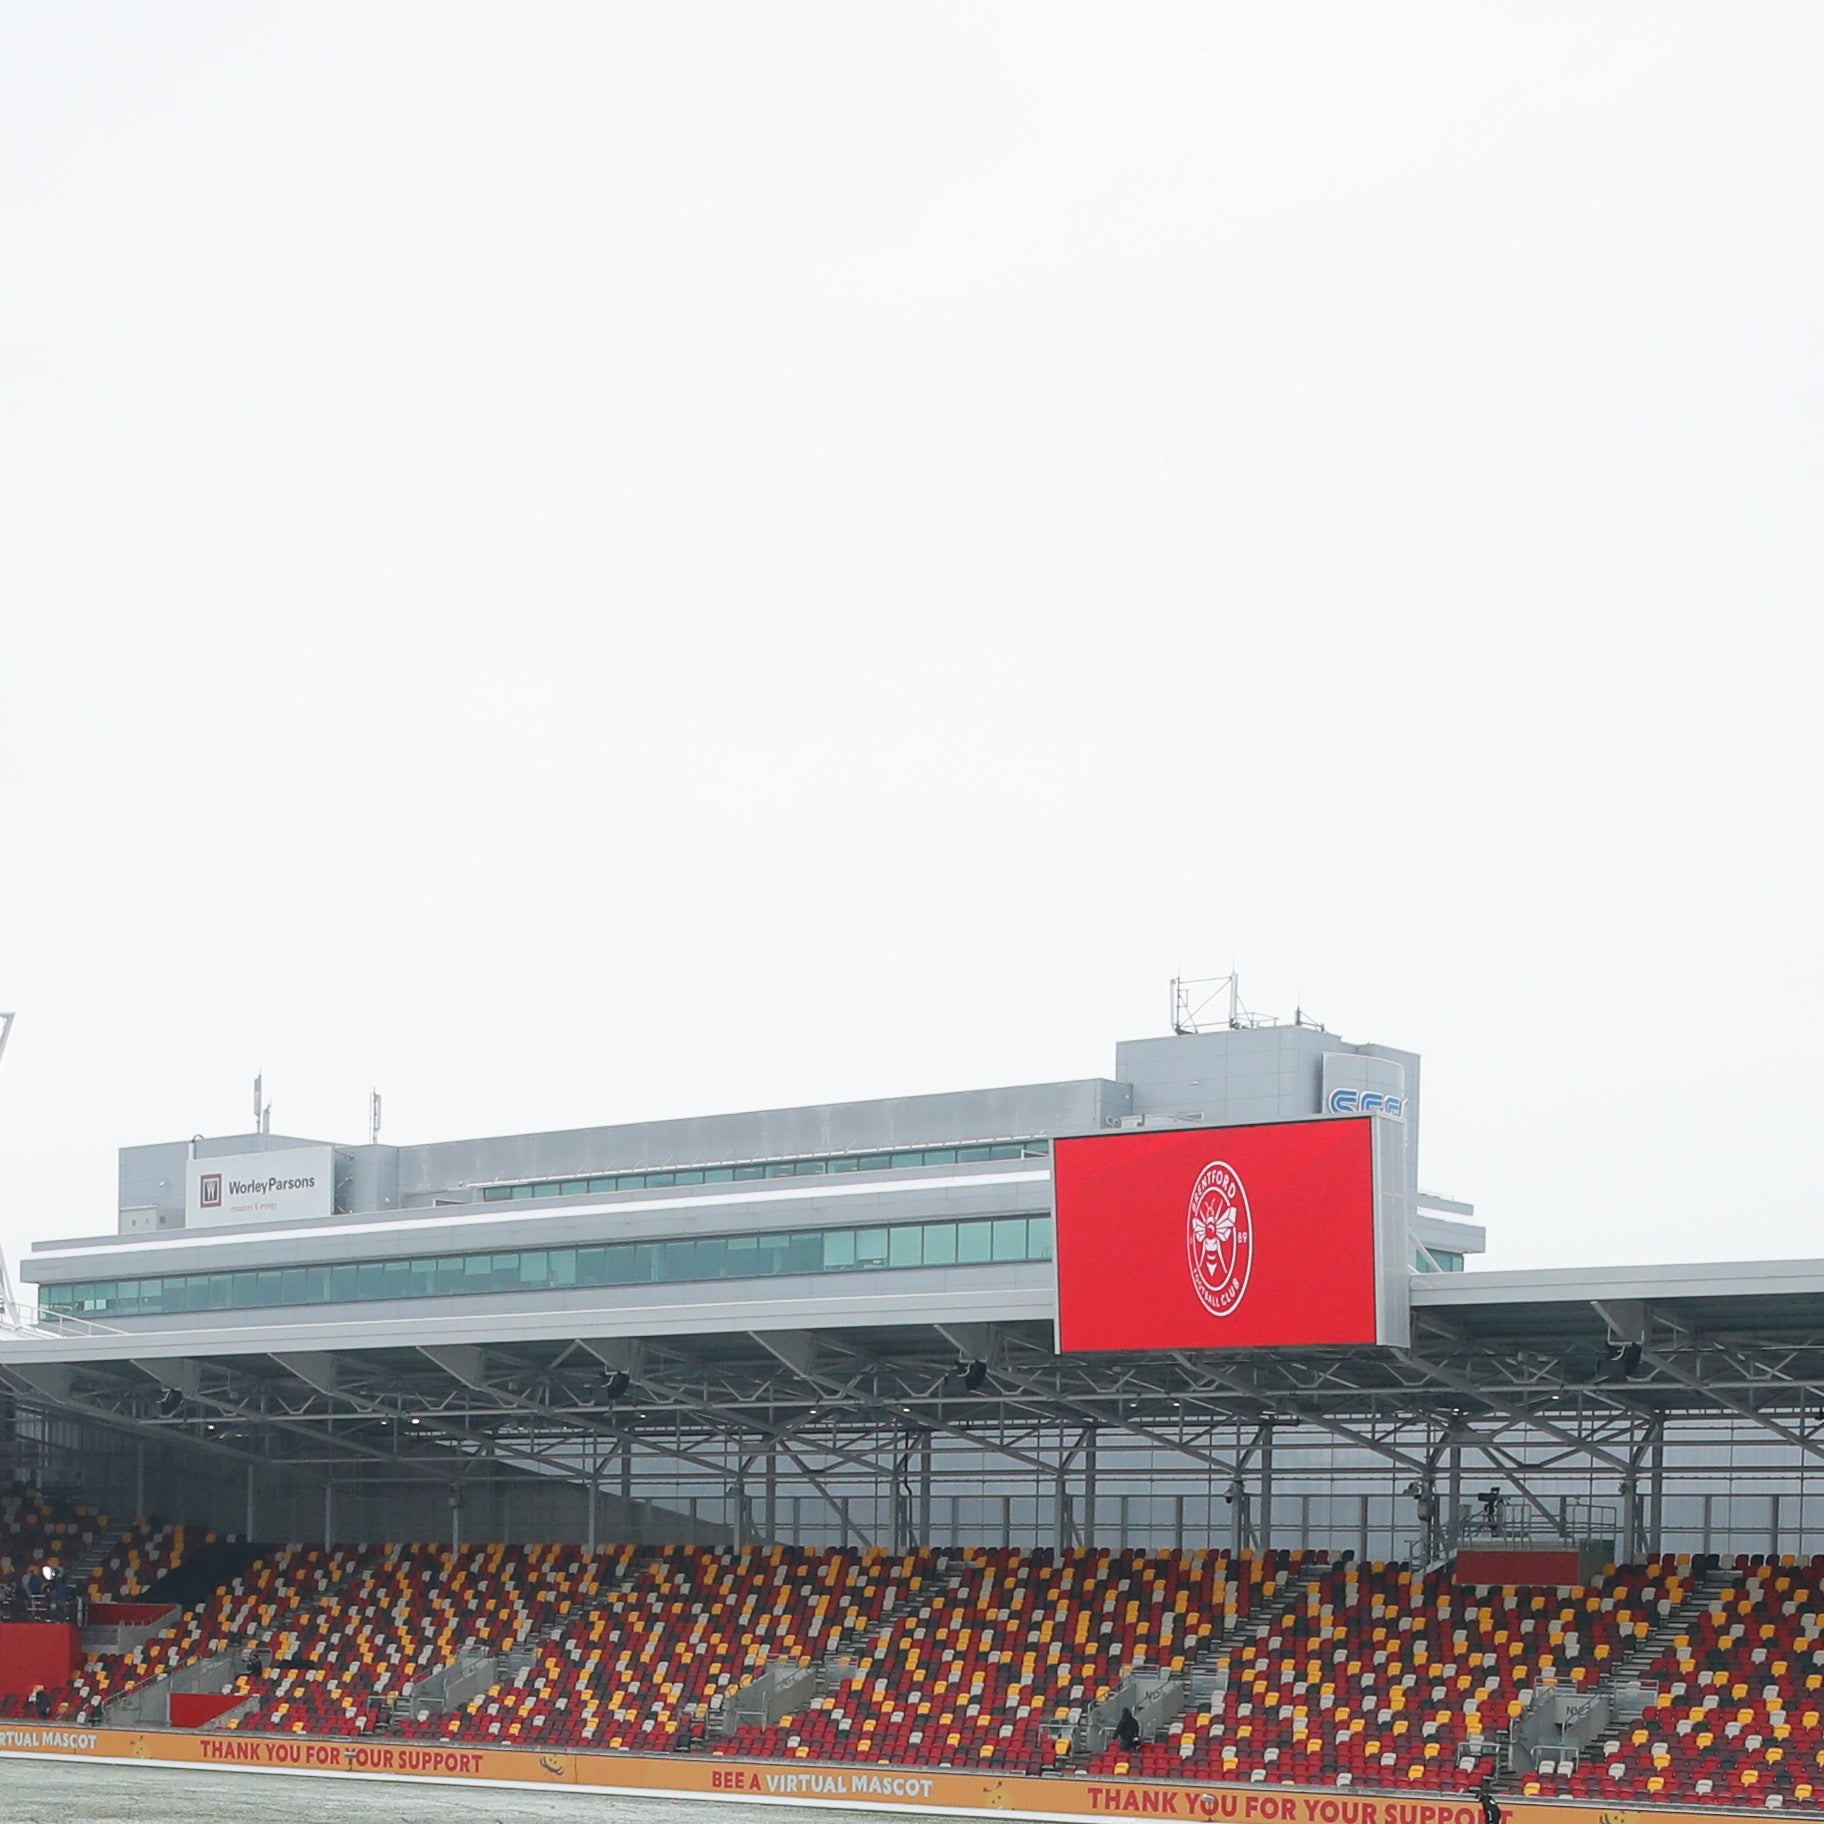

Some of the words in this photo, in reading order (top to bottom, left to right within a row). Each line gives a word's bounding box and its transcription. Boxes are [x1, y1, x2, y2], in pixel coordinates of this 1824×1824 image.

[229, 1177, 315, 1195] WorleyParsons
[1192, 1169, 1236, 1213] BRENTFORD
[42, 1732, 97, 1749] MASCOT
[200, 1740, 260, 1760] THANK
[265, 1743, 301, 1763] YOU
[306, 1746, 340, 1765] FOR
[398, 1750, 483, 1773] SUPPORT
[712, 1771, 745, 1789] BEE
[749, 1773, 761, 1791] A
[765, 1774, 847, 1793] VIRTUAL
[851, 1775, 933, 1797] MASCOT
[1087, 1787, 1178, 1813] THANK
[1184, 1792, 1238, 1817] YOU
[1245, 1796, 1296, 1820] FOR
[1302, 1799, 1377, 1824] YOUR
